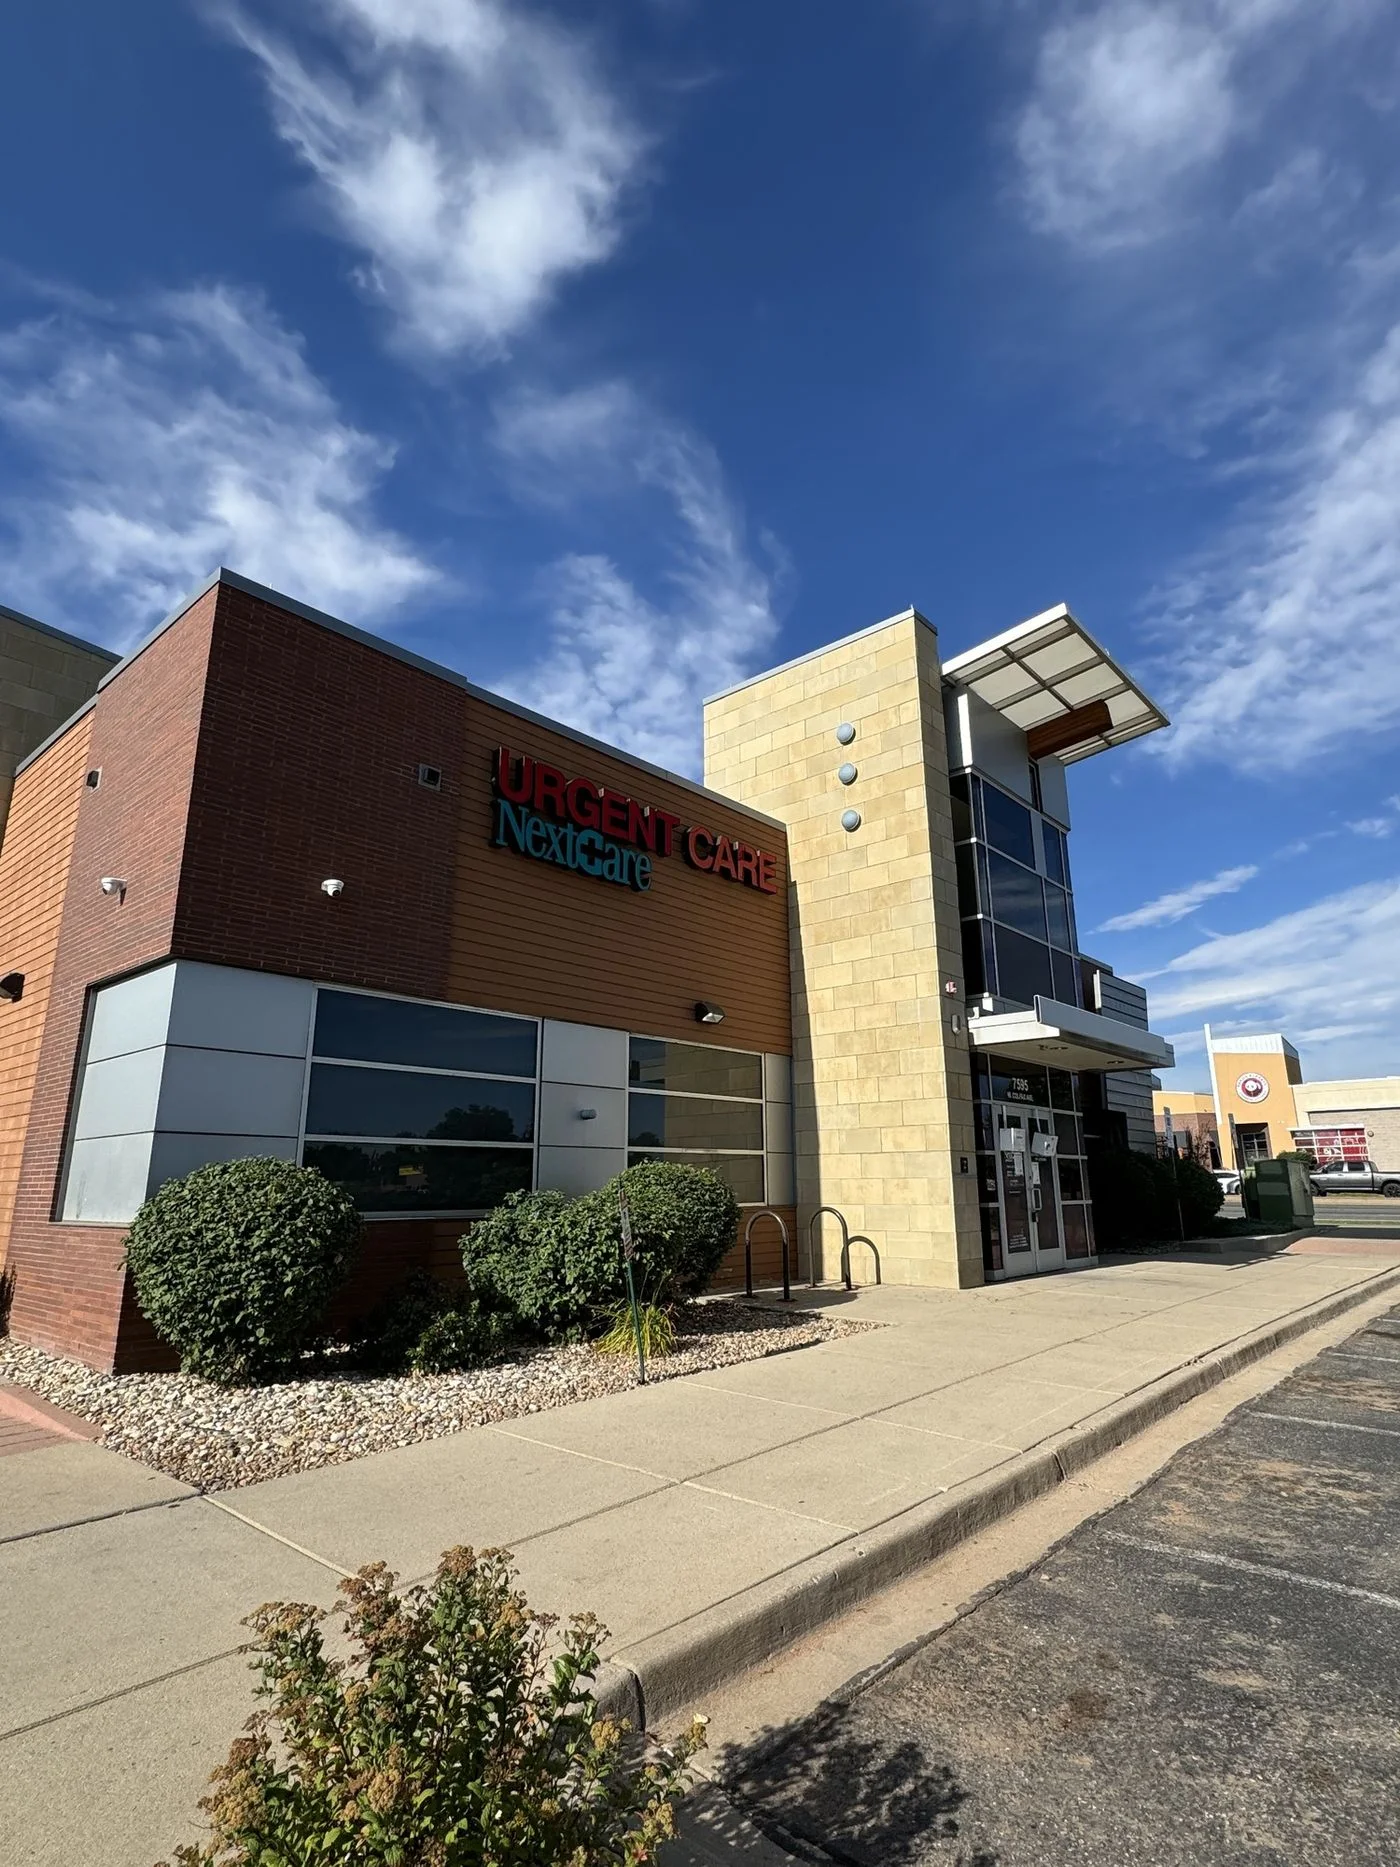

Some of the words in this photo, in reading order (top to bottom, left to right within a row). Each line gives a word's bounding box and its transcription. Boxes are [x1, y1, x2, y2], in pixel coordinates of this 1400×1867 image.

[493, 798, 653, 891] NextCare
[495, 745, 681, 857] URGENT
[685, 826, 777, 895] CARE
[1012, 1077, 1029, 1091] 7595
